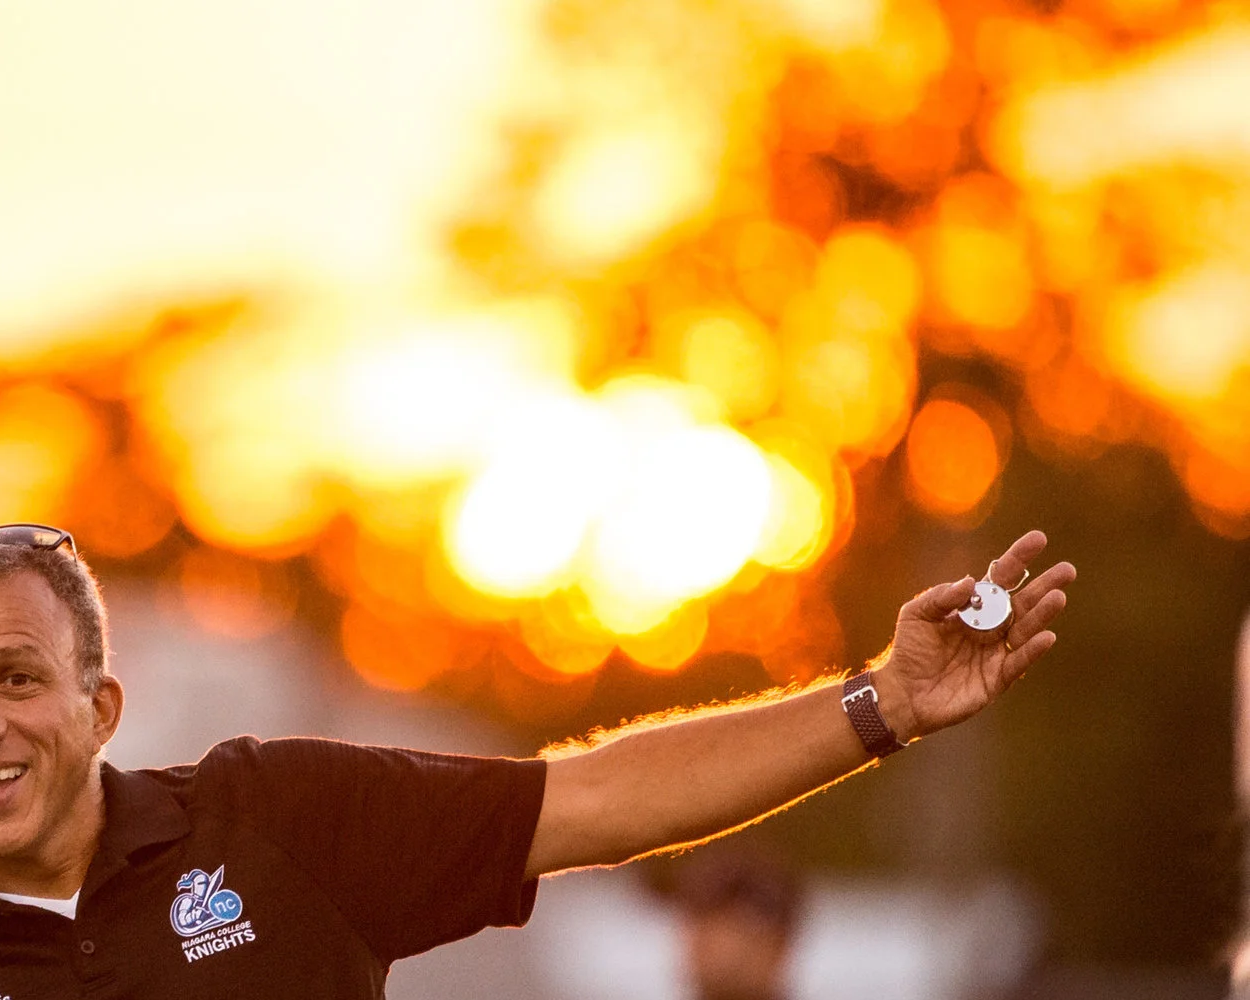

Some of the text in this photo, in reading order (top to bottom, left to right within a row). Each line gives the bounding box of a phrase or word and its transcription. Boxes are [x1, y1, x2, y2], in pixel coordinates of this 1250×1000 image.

[214, 898, 237, 913] nc
[181, 920, 252, 950] NIAGARA COLLEGE
[183, 929, 256, 963] KNIGHTS
